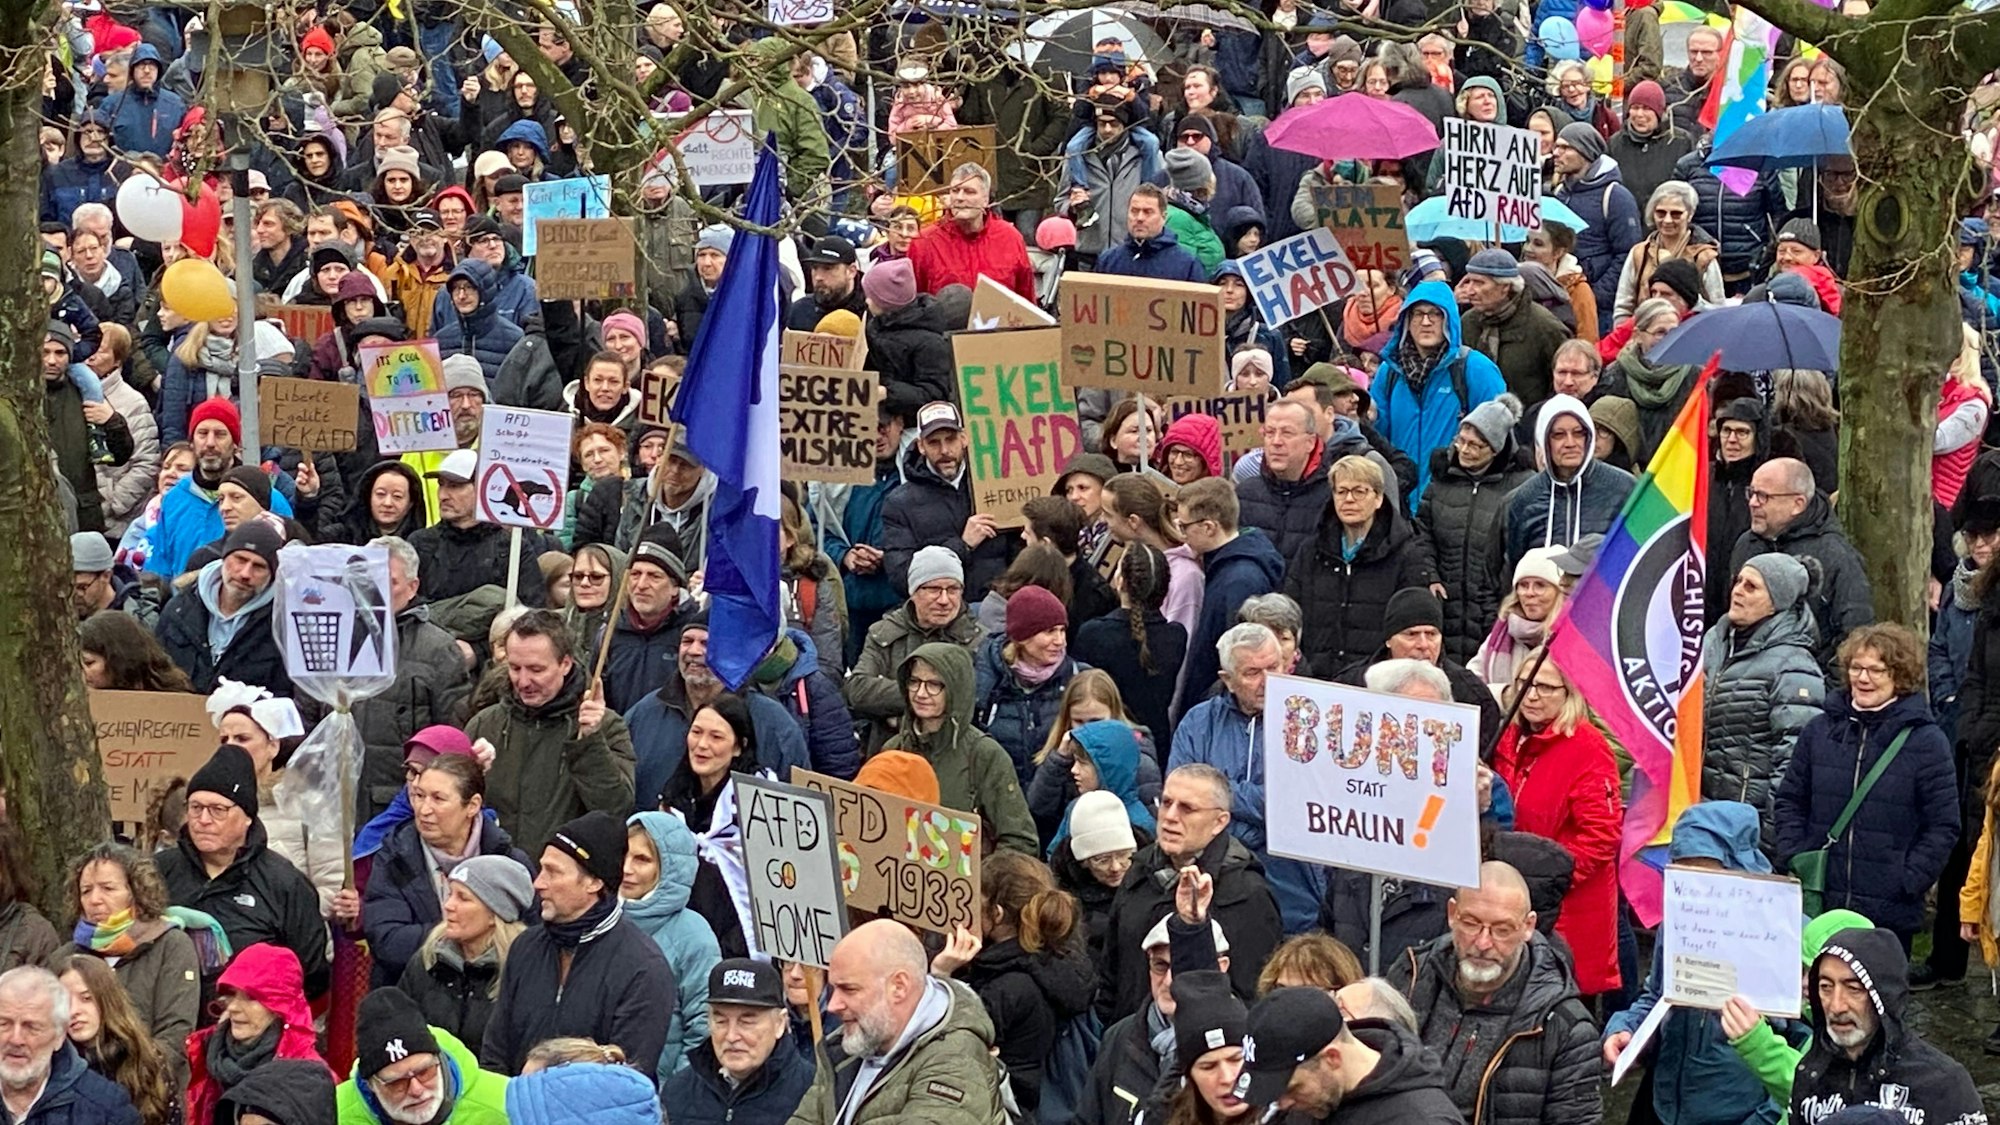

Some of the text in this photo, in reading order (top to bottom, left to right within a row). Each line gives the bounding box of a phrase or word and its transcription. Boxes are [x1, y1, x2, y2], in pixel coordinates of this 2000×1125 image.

[1447, 122, 1537, 165] HIRN AN
[1447, 153, 1540, 200] HERZ AUF
[1315, 187, 1374, 208] KEIN
[1448, 187, 1540, 230] AfD RAUS
[1318, 208, 1403, 229] PLATZ
[1243, 235, 1338, 287] EKEL
[1346, 242, 1402, 270] AZIS
[1257, 262, 1356, 326] HAfD
[1073, 294, 1218, 337] WIR SIND
[796, 341, 844, 368] KEIN
[1104, 340, 1204, 384] BUNT
[274, 382, 330, 402] Liberté
[386, 375, 399, 386] TO
[780, 373, 870, 406] GEGEN
[961, 361, 1076, 416] EKEL
[504, 413, 530, 427] AFD
[780, 438, 874, 468] MISMUS
[970, 414, 1083, 480] HAfD
[97, 719, 201, 745] SCHENRECHTE
[1283, 694, 1462, 787] BUNT
[105, 749, 176, 768] STATT
[1346, 778, 1388, 798] STATT
[905, 807, 978, 876] IST
[766, 858, 797, 889] GO
[875, 855, 973, 931] 1933
[755, 897, 835, 965] HOME
[723, 975, 756, 988] DONE
